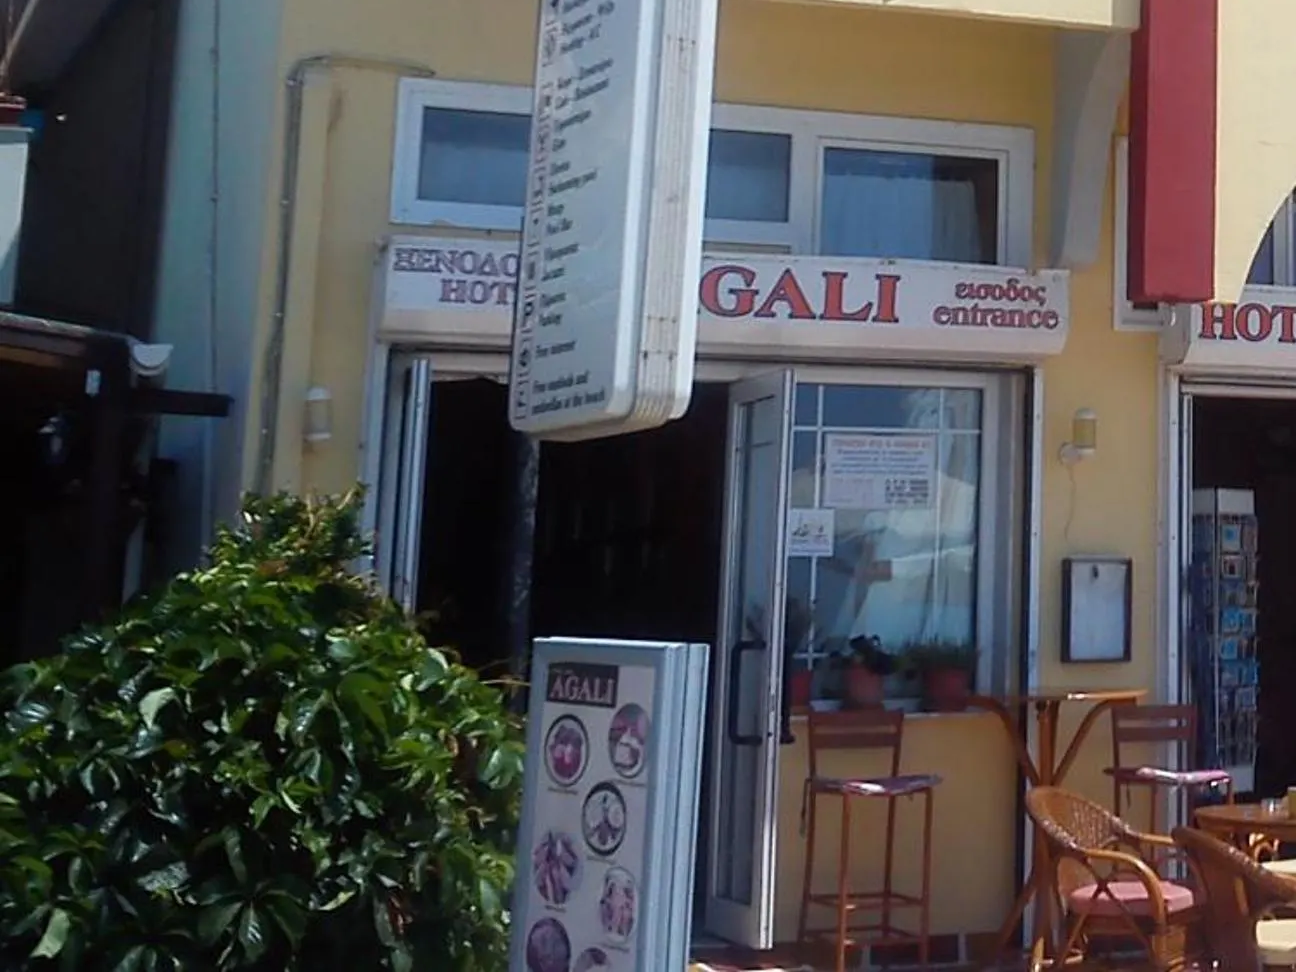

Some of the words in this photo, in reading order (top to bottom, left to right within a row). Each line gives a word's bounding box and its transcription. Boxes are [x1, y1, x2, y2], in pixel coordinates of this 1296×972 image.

[393, 247, 519, 277] ΞΕΝΟΔΟ
[438, 278, 517, 306] HOT
[697, 264, 902, 324] GALI
[932, 302, 1060, 330] entrance
[549, 675, 616, 704] AGALI
